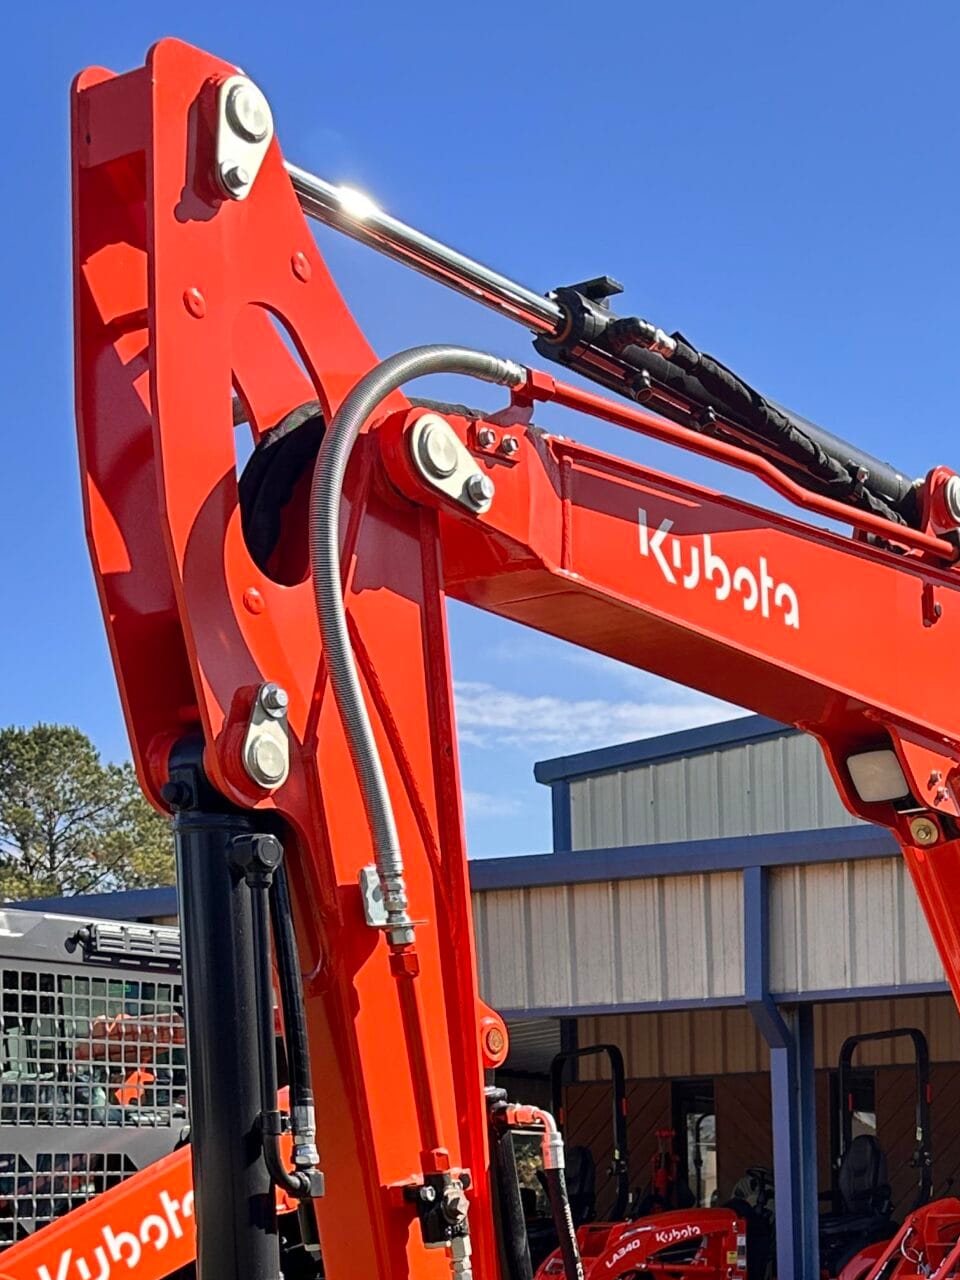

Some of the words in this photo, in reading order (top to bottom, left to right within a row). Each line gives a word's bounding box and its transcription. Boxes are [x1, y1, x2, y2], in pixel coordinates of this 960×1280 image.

[638, 507, 799, 629] Kubota
[656, 1225, 701, 1243] Kubota
[605, 1239, 641, 1269] LA340
